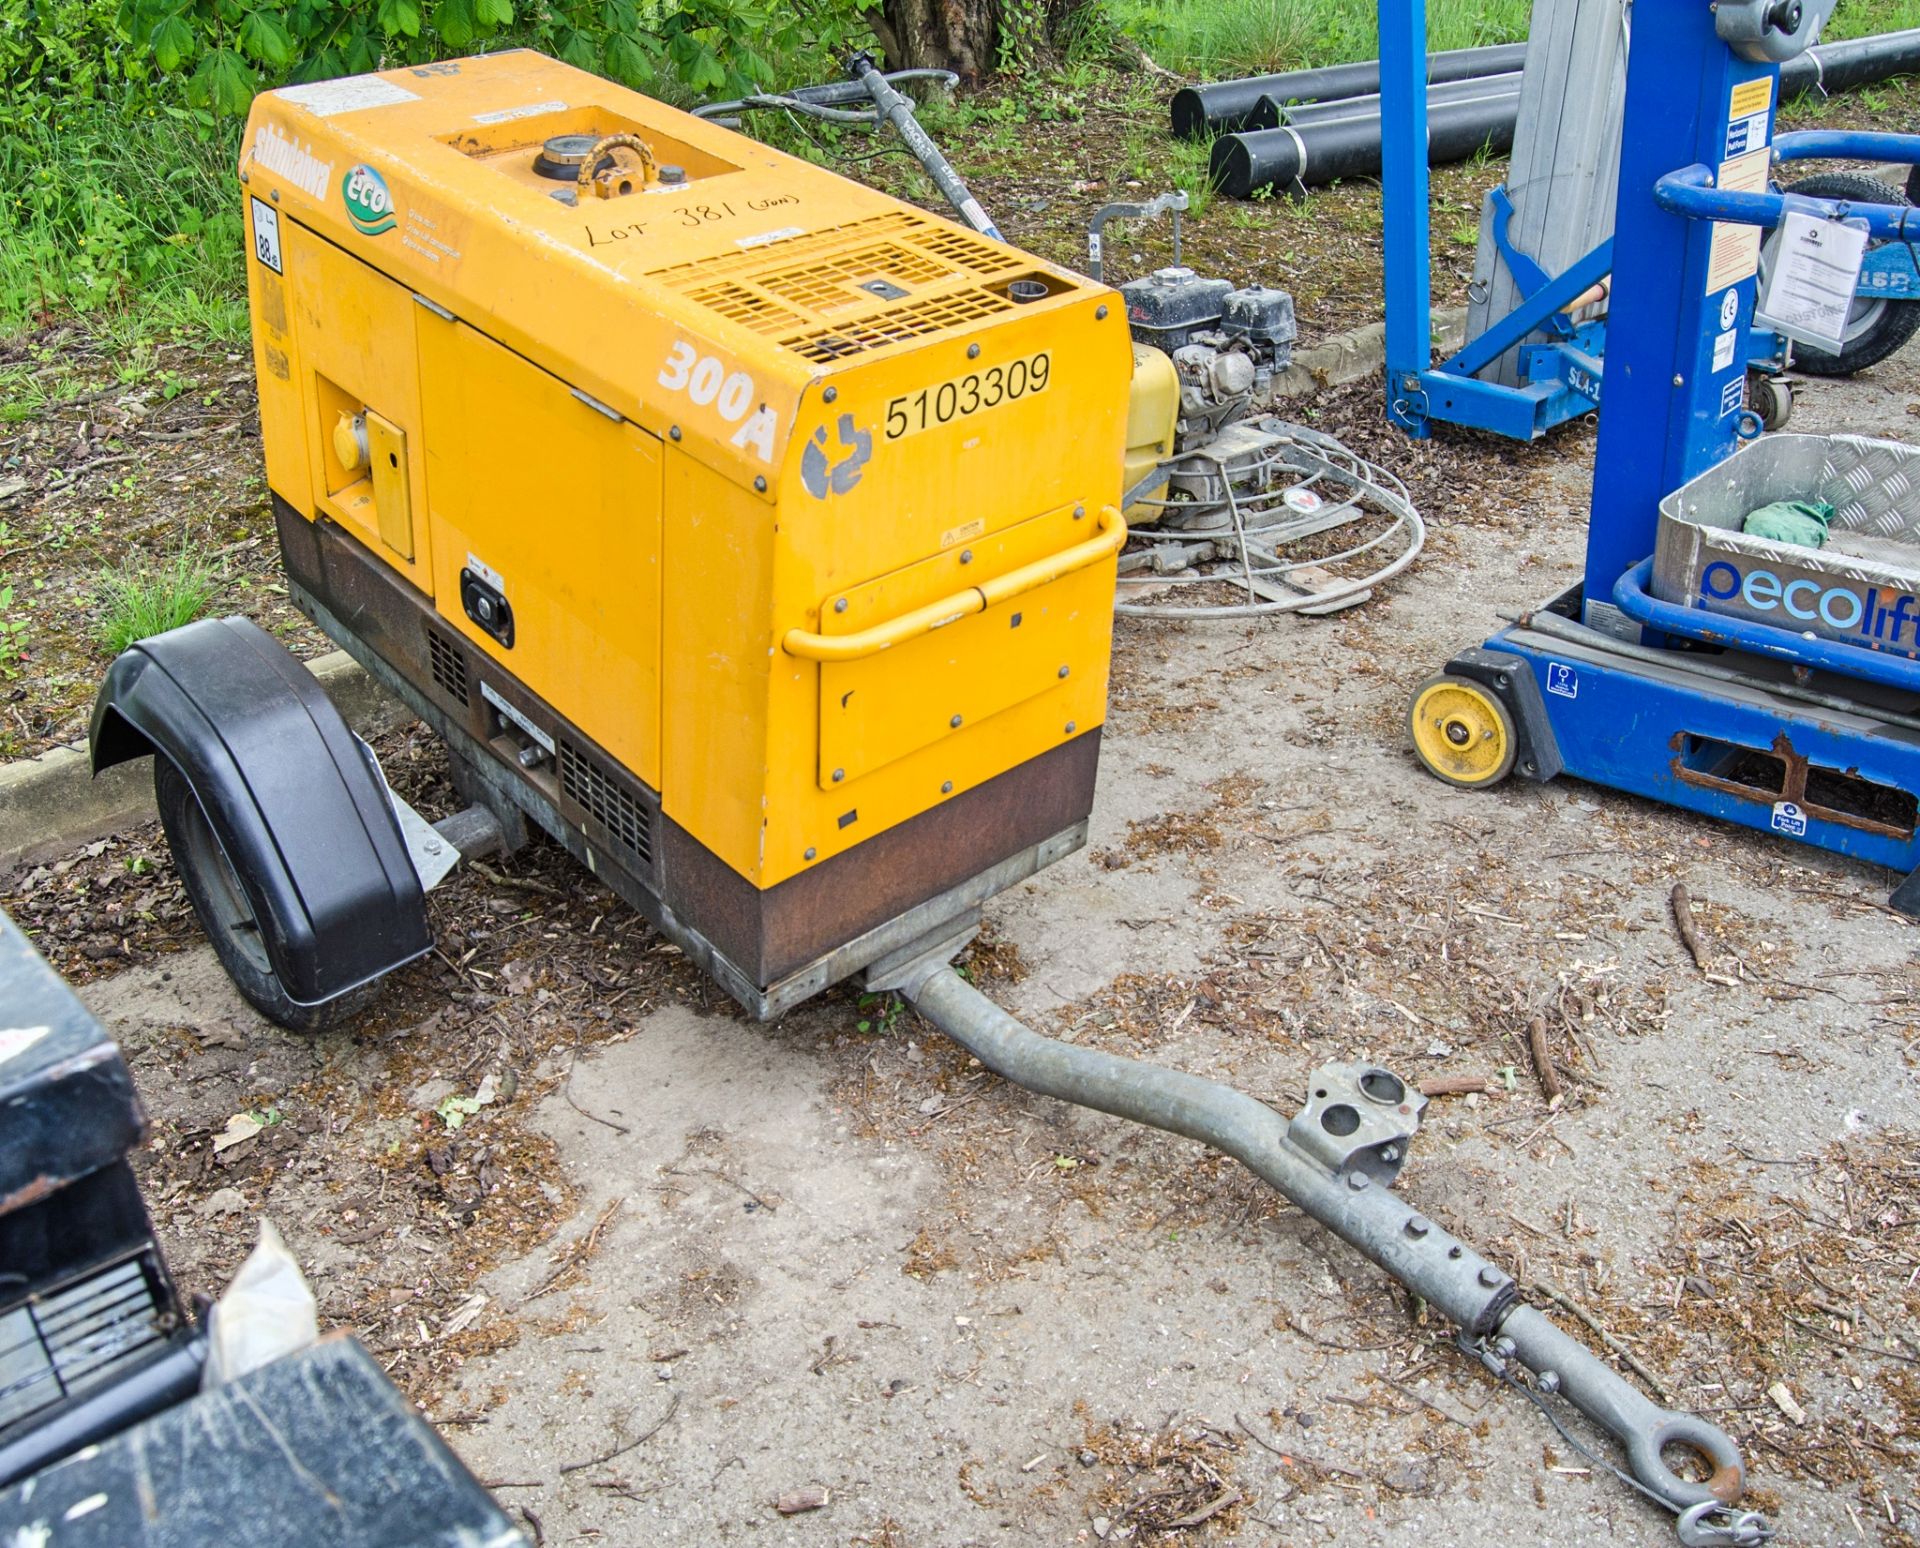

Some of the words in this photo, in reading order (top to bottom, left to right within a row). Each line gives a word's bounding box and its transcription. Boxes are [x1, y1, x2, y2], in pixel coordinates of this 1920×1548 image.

[254, 122, 331, 202] shindaiwa
[347, 175, 387, 213] eco
[672, 201, 737, 227] 381
[259, 233, 272, 263] 88
[885, 352, 1051, 440] 5103309
